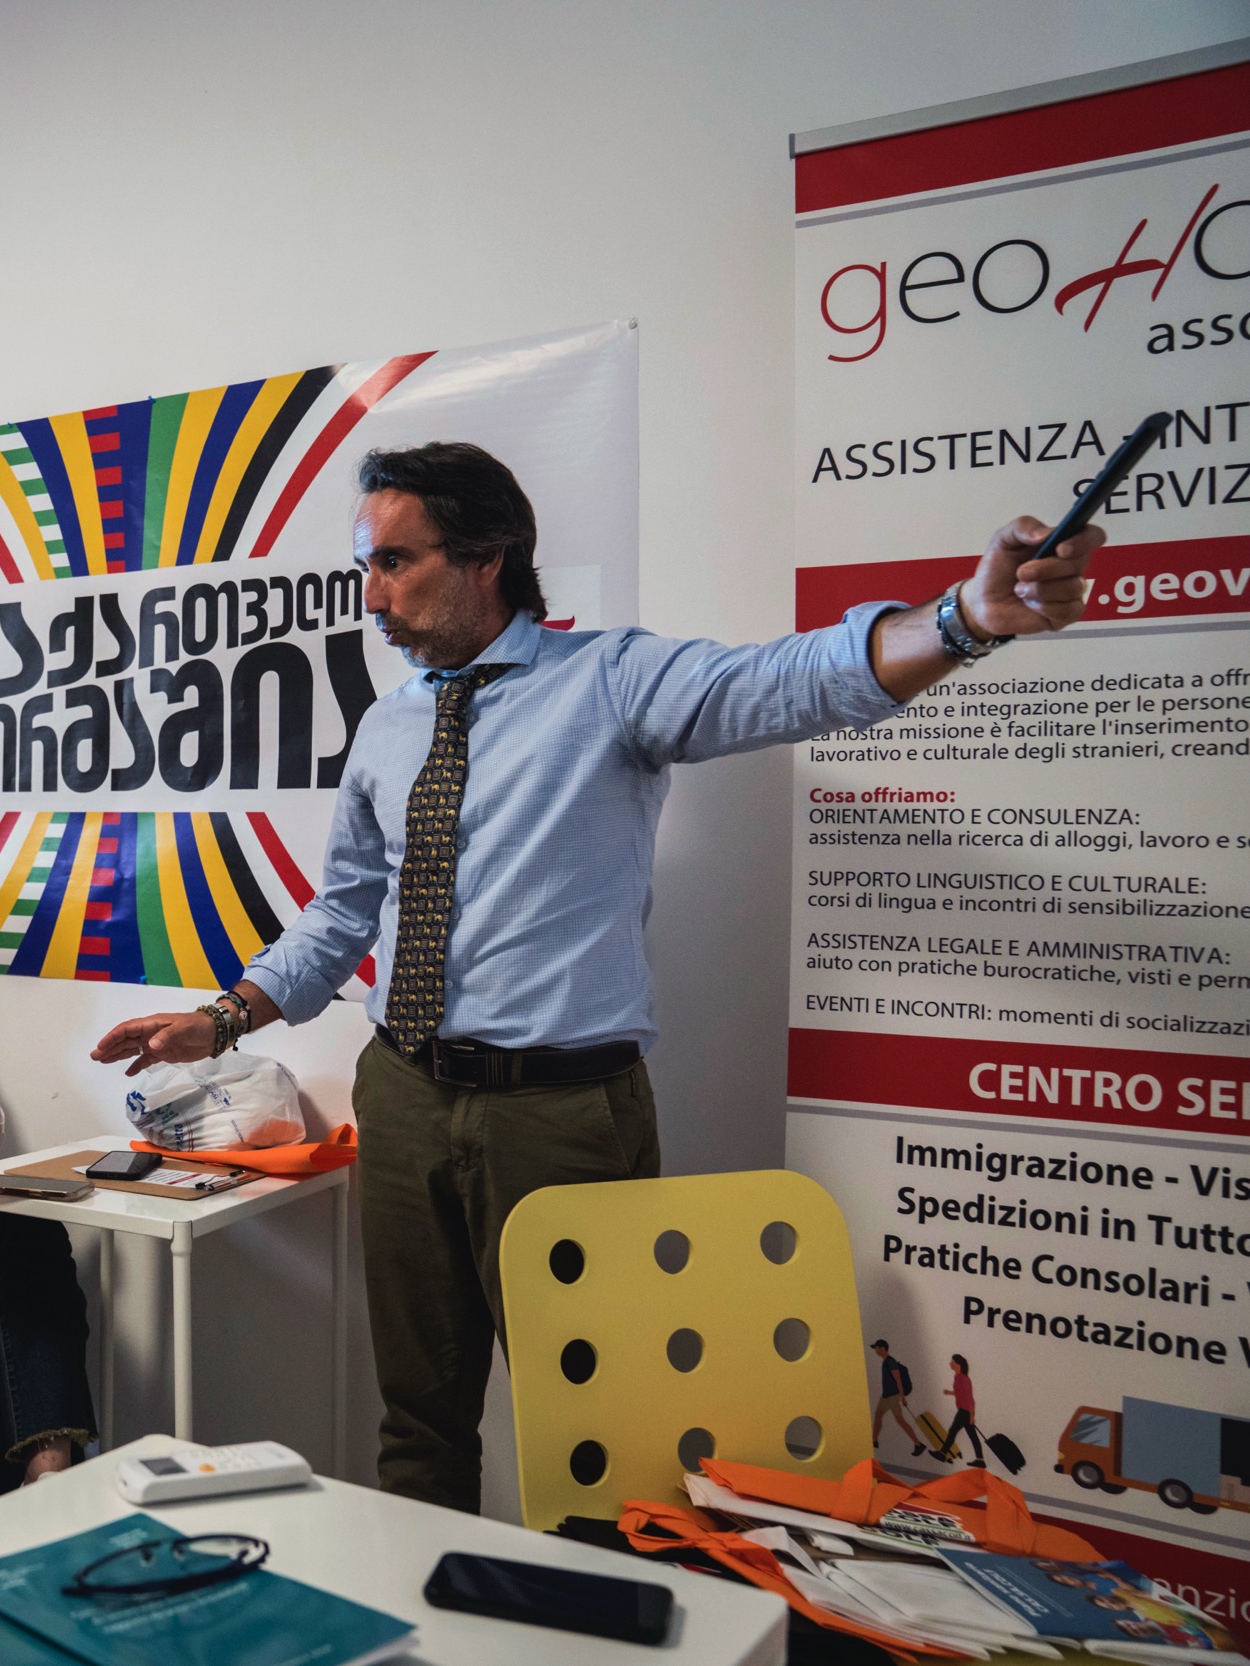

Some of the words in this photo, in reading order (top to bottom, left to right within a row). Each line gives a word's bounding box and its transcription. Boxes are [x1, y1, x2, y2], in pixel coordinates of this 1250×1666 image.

[811, 419, 1107, 485] ASSISTENZA
[925, 677, 1086, 698] un'associazione
[1090, 672, 1185, 692] dedicata
[1190, 674, 1204, 688] a
[943, 705, 956, 718] e
[960, 701, 1089, 721] integrazione
[1094, 700, 1131, 722] per
[1136, 694, 1156, 713] le
[1161, 695, 1250, 716] persone
[835, 725, 895, 742] nostra
[899, 723, 985, 740] missione
[989, 721, 1002, 738] è
[1006, 719, 1096, 738] facilitare
[1102, 716, 1250, 736] l'inserimento
[810, 745, 902, 763] lavorativo
[906, 748, 918, 761] e
[922, 742, 1010, 761] culturale
[1014, 741, 1066, 764] degli
[1071, 740, 1165, 760] stranieri,
[1171, 737, 1250, 757] creand
[809, 787, 856, 804] Cosa
[860, 786, 956, 804] offriamo:
[808, 808, 966, 825] ORIENTAMENTO
[971, 808, 982, 825] E
[987, 808, 1140, 826] CONSULENZA:
[808, 829, 901, 846] assistenza
[906, 828, 953, 846] nella
[958, 830, 1024, 847] ricerca
[1029, 829, 1049, 848] di
[1054, 829, 1133, 853] alloggi,
[1140, 830, 1210, 849] lavoro
[1215, 835, 1231, 849] e
[1236, 835, 1250, 849] s
[808, 870, 912, 889] SUPPORTO
[916, 872, 1045, 892] LINGUISTICO
[1051, 874, 1063, 892] E
[1067, 874, 1207, 895] CULTURALE:
[807, 891, 850, 908] corsi
[854, 891, 873, 909] di
[878, 891, 937, 914] lingua
[941, 898, 954, 911] e
[959, 894, 1037, 913] incontri
[1042, 895, 1062, 914] di
[1067, 897, 1250, 920] sensibilizzazione
[806, 932, 921, 953] ASSISTENZA
[927, 936, 1003, 956] LEGALE
[1008, 939, 1020, 957] E
[1025, 940, 1231, 966] AMMINISTRATIVA:
[806, 953, 854, 971] aiuto
[857, 959, 892, 973] con
[897, 958, 978, 977] pratiche
[983, 959, 1122, 986] burocratiche,
[1127, 967, 1172, 986] visti
[1177, 973, 1192, 987] e
[806, 994, 870, 1014] EVENTI
[875, 998, 886, 1015] E
[891, 999, 992, 1021] INCONTRI:
[998, 1009, 1094, 1027] momenti
[1099, 1010, 1120, 1029] di
[968, 1062, 1163, 1112] CENTRO
[895, 1135, 1154, 1191] Immigrazione
[1189, 1164, 1250, 1202] Vis
[896, 1186, 1090, 1237] Spedizioni
[1100, 1207, 1136, 1243] in
[1146, 1213, 1250, 1258] Tutto
[883, 1233, 1023, 1281] Pratiche
[1031, 1253, 1211, 1308] Consolari
[962, 1295, 1228, 1365] Prenotazione
